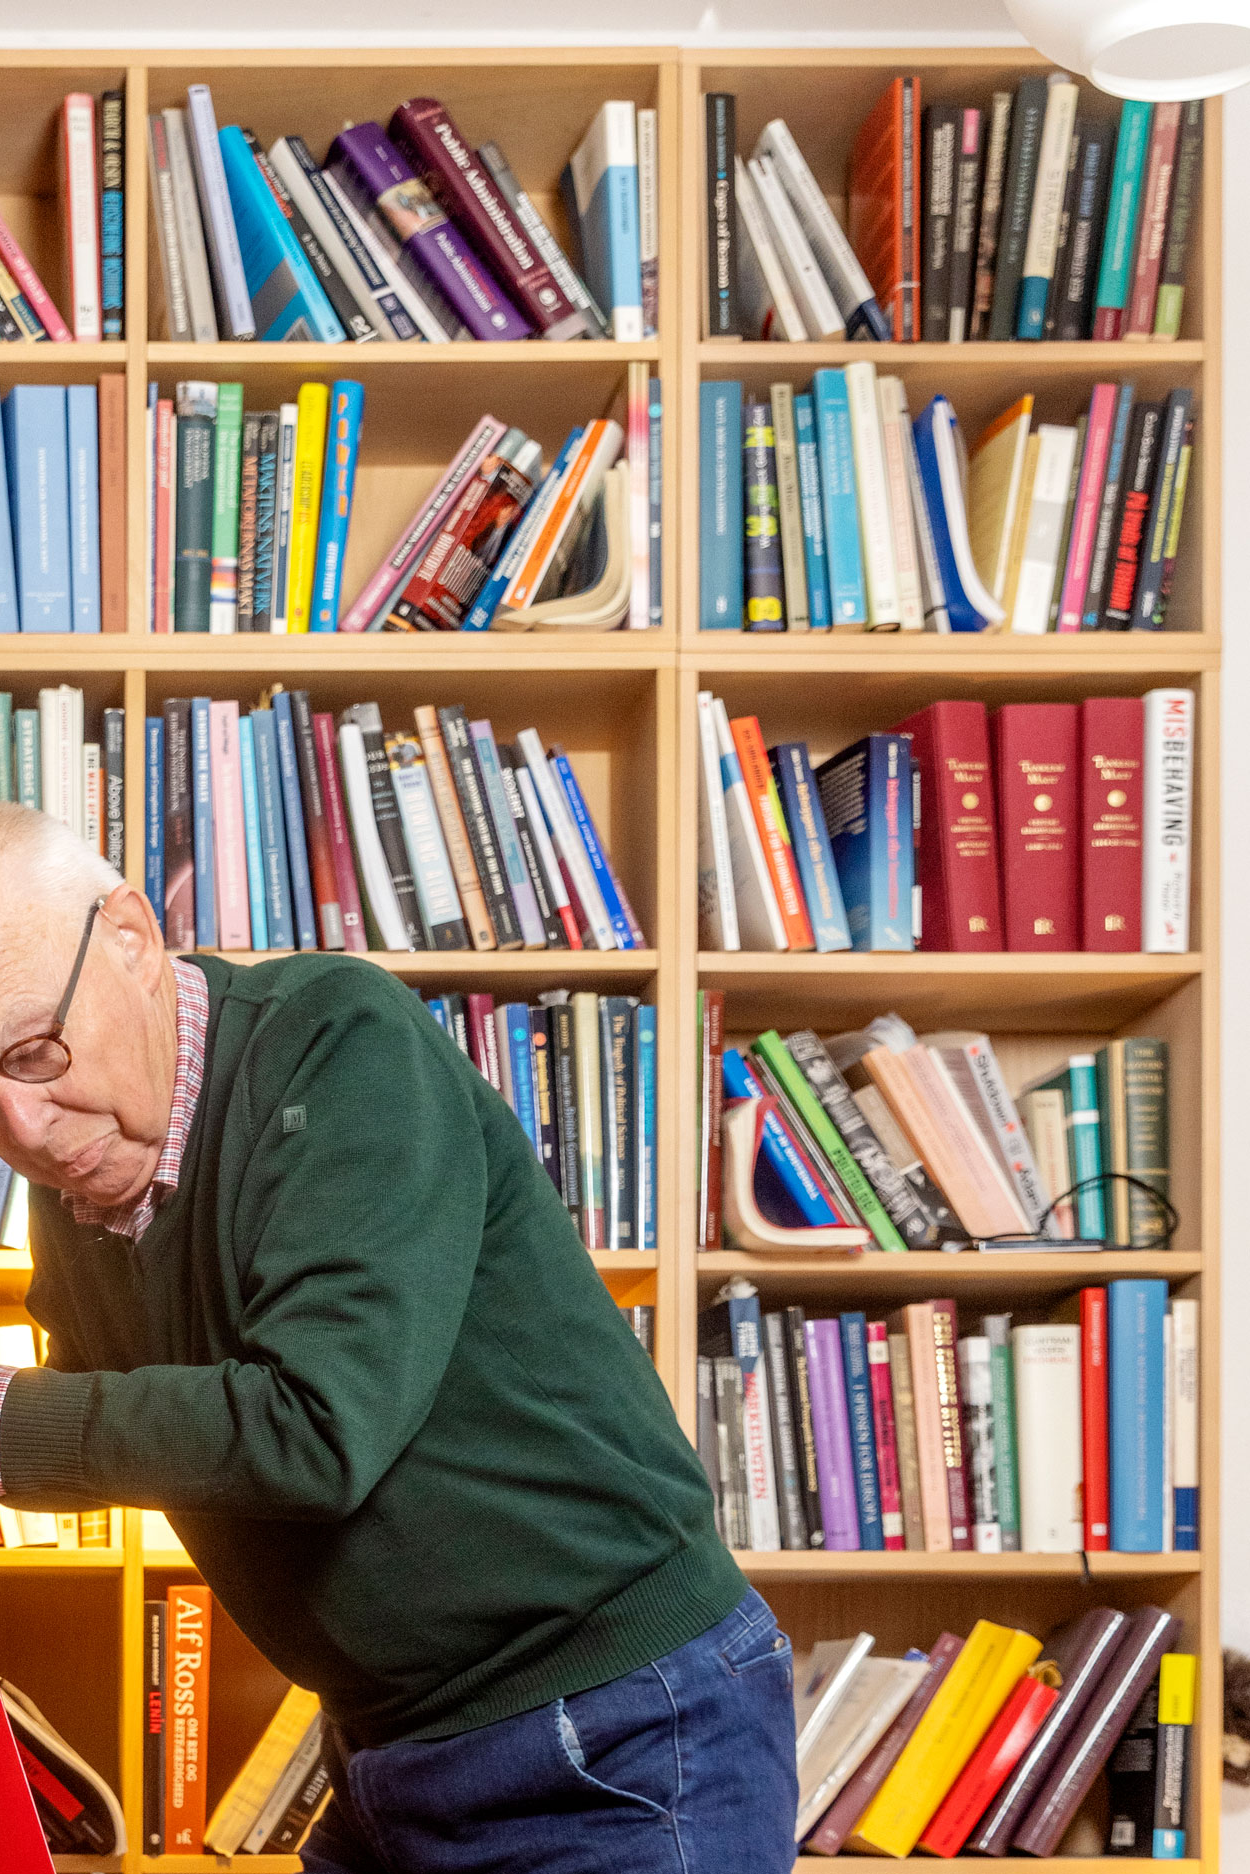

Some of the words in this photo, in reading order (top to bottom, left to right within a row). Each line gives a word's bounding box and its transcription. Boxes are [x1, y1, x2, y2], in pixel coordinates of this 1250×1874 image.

[433, 120, 473, 171] Public
[461, 164, 537, 271] Administration
[713, 179, 730, 221] Cages
[714, 221, 730, 237] of
[434, 229, 459, 260] Public
[450, 255, 492, 314] Administration
[715, 237, 730, 288] Reason
[239, 455, 257, 570] METAFORERNAS
[238, 571, 254, 616] MAKT
[196, 709, 207, 750] BENDING
[21, 719, 34, 795] STRATEGIC
[197, 753, 207, 770] THE
[1161, 698, 1186, 846] MISBEHAVING
[107, 774, 123, 818] Above
[197, 773, 208, 803] RULES
[499, 766, 525, 819] SKOLERET
[758, 794, 778, 832] FORSVAR
[107, 821, 123, 868] Politics
[405, 789, 440, 863] BOWLING
[423, 869, 453, 917] ALONE
[767, 831, 783, 850] FOR
[771, 850, 800, 916] RATIONALITETEN
[612, 1015, 625, 1034] The
[482, 1013, 500, 1091] TRANSFORMING
[613, 1036, 626, 1073] Tragedy
[563, 1106, 576, 1141] British
[614, 1086, 626, 1123] Political
[615, 1125, 627, 1160] Science
[565, 1142, 579, 1206] Government
[932, 1311, 953, 1346] DEN
[935, 1347, 957, 1405] FJERDE
[743, 1371, 767, 1500] MØRKELYGTEN
[853, 1391, 870, 1442] SPIDSEN
[940, 1406, 962, 1469] RYTTER
[857, 1444, 873, 1471] FOR
[860, 1472, 878, 1524] EUROPA
[174, 1597, 204, 1647] Alf
[173, 1650, 203, 1716] Ross
[171, 1717, 184, 1808] RETFÆRDIGHED
[185, 1739, 197, 1762] RET
